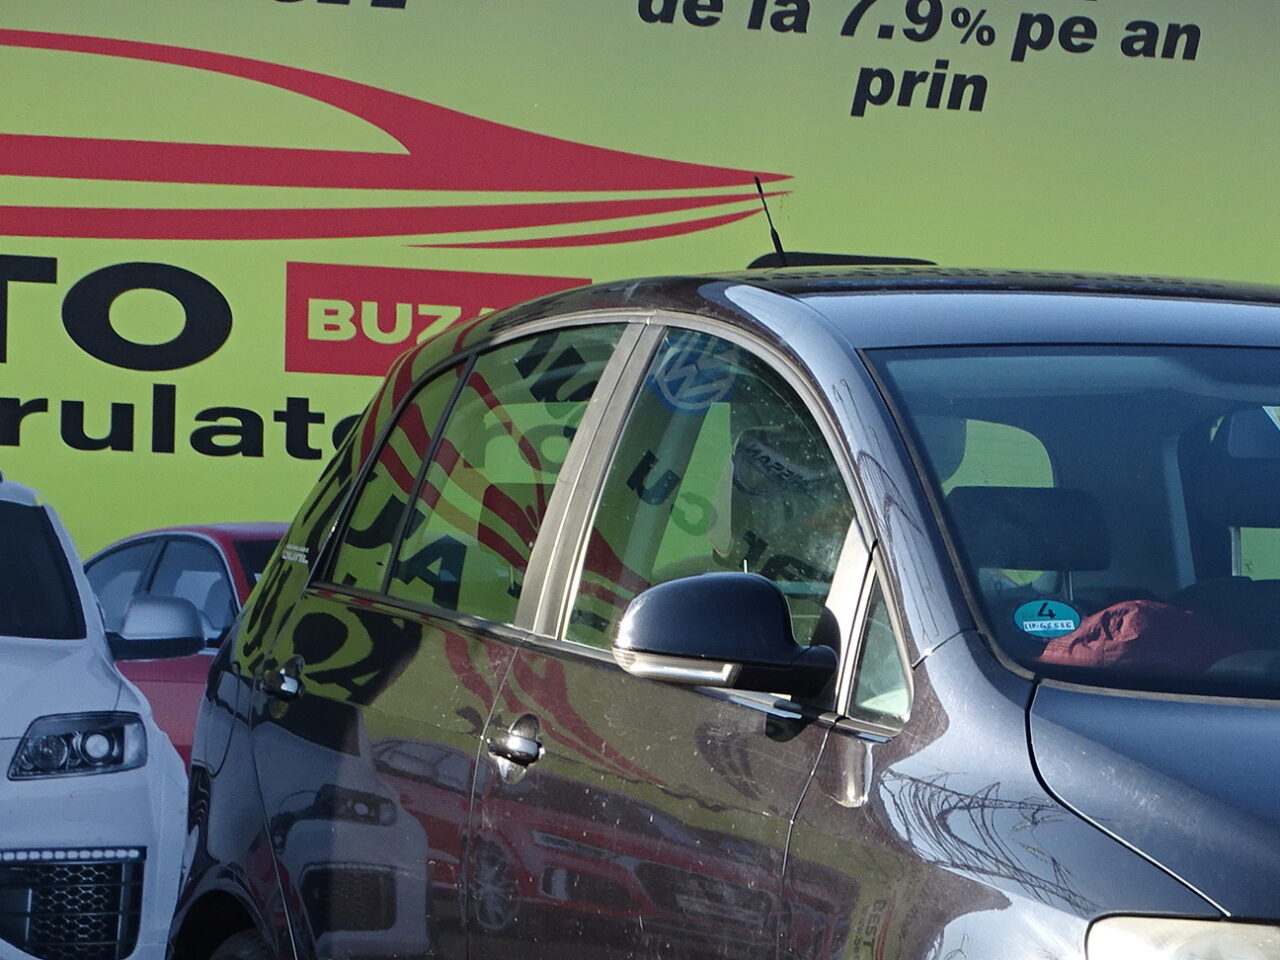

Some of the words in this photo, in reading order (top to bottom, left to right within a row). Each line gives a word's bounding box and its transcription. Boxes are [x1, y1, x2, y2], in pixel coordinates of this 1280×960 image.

[1010, 13, 1098, 62] pe
[1120, 20, 1201, 61] an
[850, 59, 988, 117] prin
[307, 298, 496, 345] BUZ
[1037, 602, 1056, 619] 4
